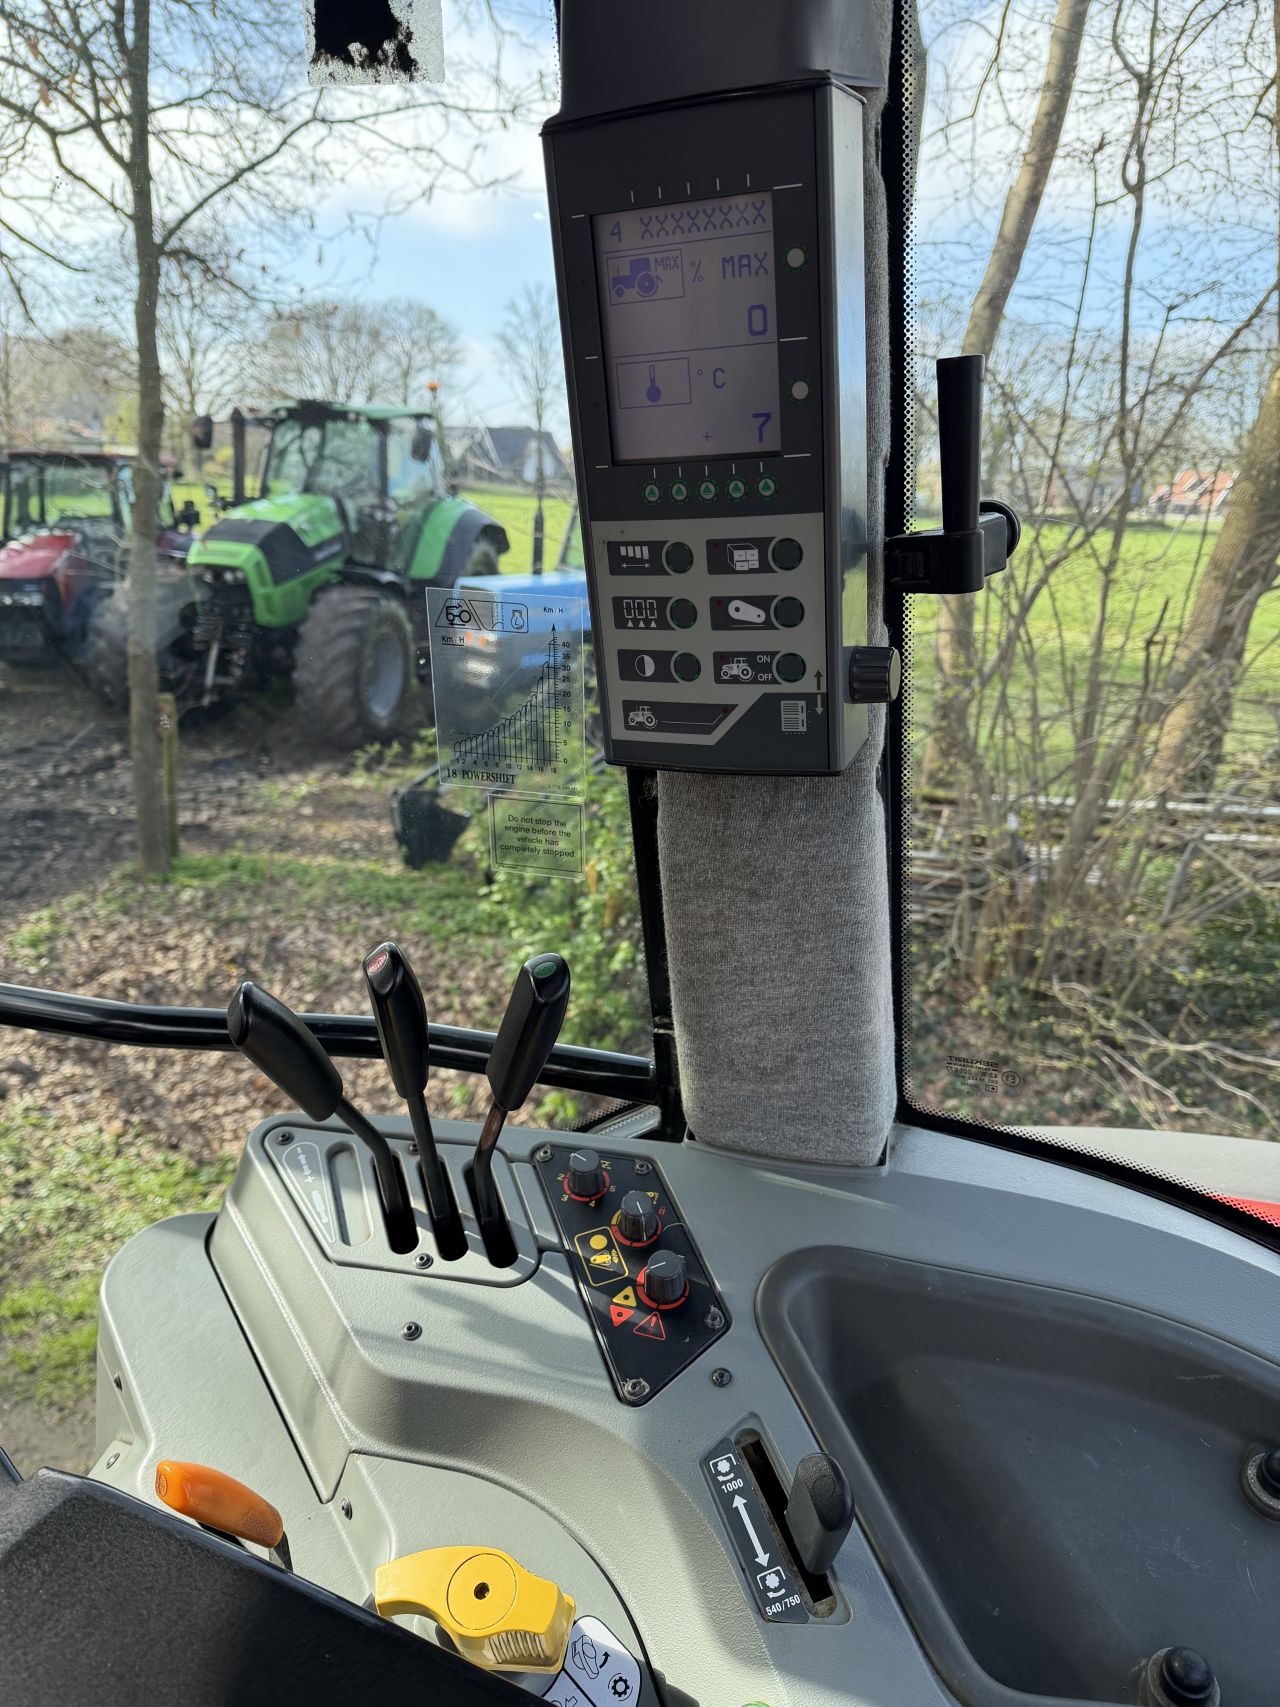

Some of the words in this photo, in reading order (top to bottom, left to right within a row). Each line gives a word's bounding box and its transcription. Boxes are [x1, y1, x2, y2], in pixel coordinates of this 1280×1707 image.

[609, 220, 622, 243] 4
[640, 200, 767, 240] XXXXXXXX
[654, 254, 680, 272] MAX
[721, 252, 769, 279] MAX
[747, 304, 768, 336] 0
[752, 412, 772, 442] 7
[756, 655, 771, 663] ON
[561, 675, 571, 683] 25
[757, 673, 773, 681] OFF
[446, 767, 458, 779] 18
[462, 769, 517, 785] POWERSHIFT
[508, 814, 519, 822] Do
[521, 816, 533, 824] not
[535, 818, 552, 827] stop
[504, 825, 530, 834] engine
[531, 827, 557, 836] before
[500, 843, 541, 854] completely
[517, 836, 543, 844] vehicle
[545, 838, 559, 846] has
[720, 1478, 744, 1494] 1000
[765, 1593, 801, 1616] 540/750
